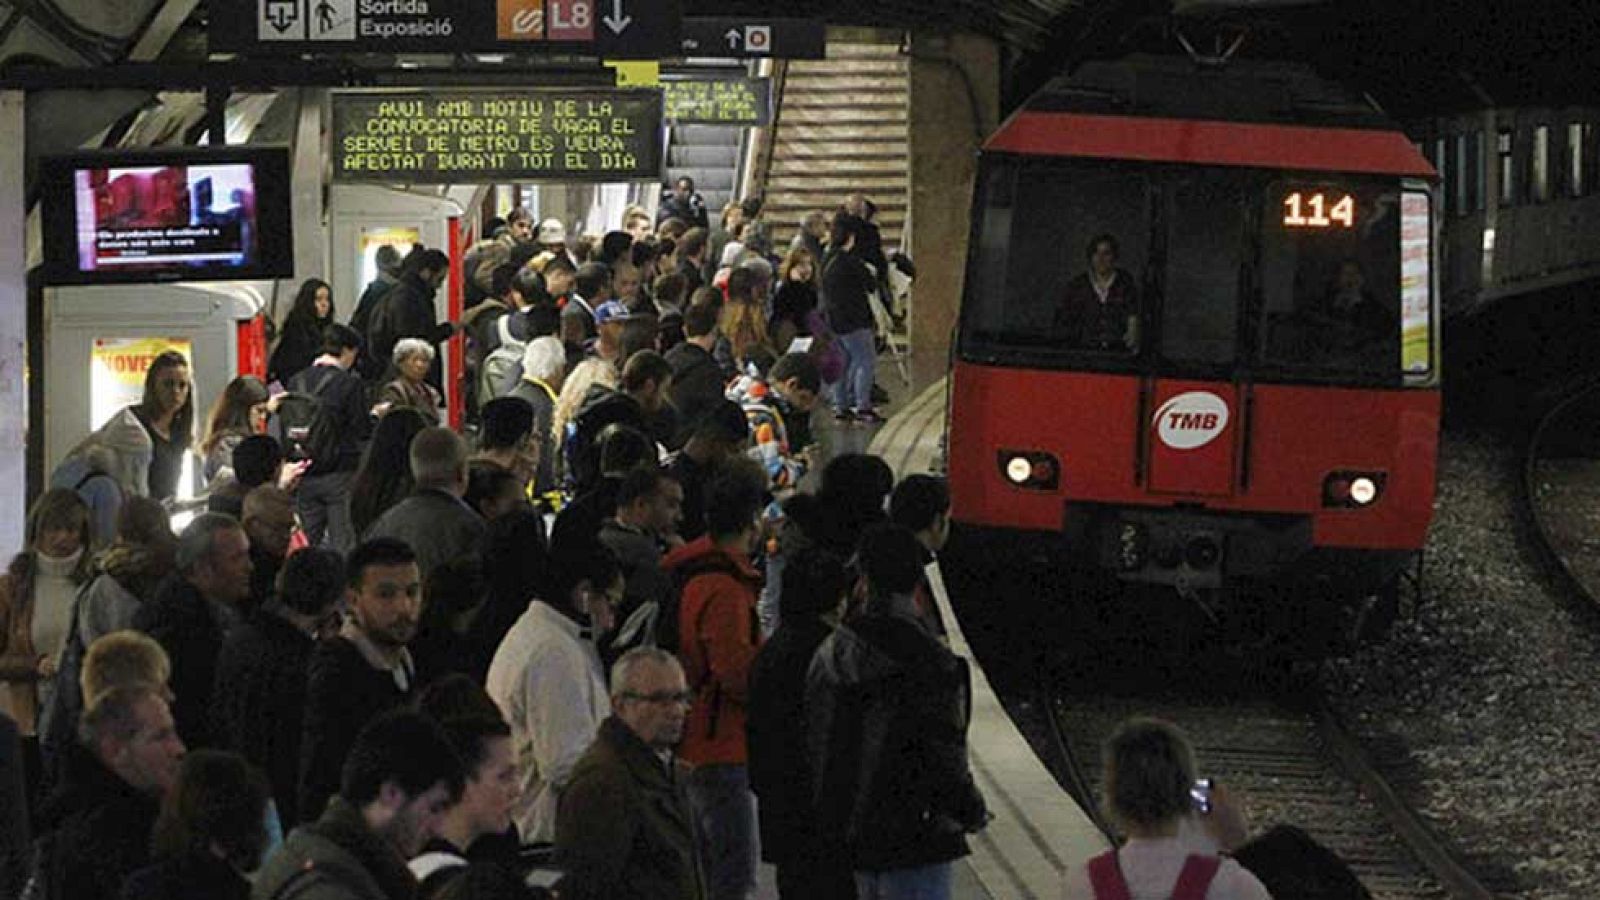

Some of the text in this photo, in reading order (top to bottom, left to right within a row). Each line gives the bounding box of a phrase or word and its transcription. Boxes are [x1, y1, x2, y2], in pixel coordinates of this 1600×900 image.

[359, 0, 429, 15] Sortida
[551, 2, 590, 30] L8
[360, 17, 452, 39] Exposició
[378, 100, 613, 117] AVUI AMB MOTIU DE LA
[366, 118, 636, 135] CONVOCATORIA DE VAGA EL
[343, 135, 625, 153] SERVEI DE METRO ES VEURA
[343, 153, 426, 171] AFECTAT
[518, 152, 553, 169] TOT
[564, 152, 590, 169] EL
[600, 152, 637, 169] DIA
[1283, 192, 1354, 229] 114
[1168, 412, 1219, 431] TMB
